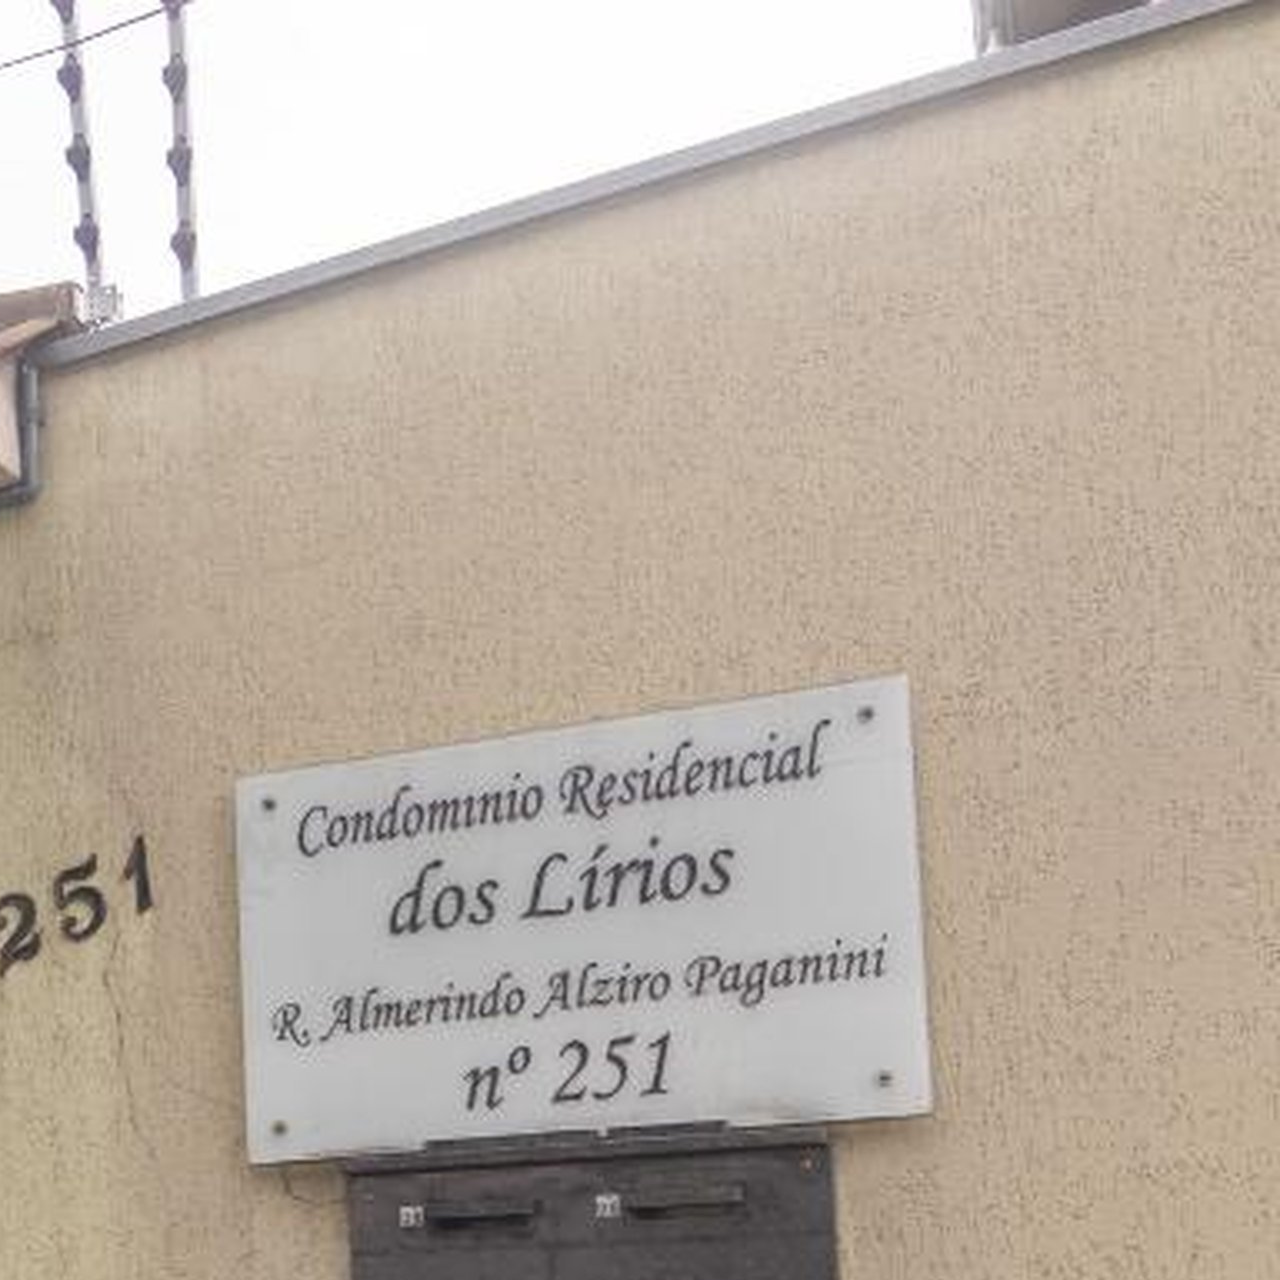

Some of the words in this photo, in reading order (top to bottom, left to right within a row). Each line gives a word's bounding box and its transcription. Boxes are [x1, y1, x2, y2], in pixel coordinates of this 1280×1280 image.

[559, 719, 831, 821] Residencial
[388, 859, 499, 935] dos
[520, 836, 735, 920] Lírios
[319, 971, 526, 1042] Almerindo
[532, 962, 671, 1019] Alziro
[684, 932, 888, 1007] Paganini
[551, 1030, 671, 1104] 251
